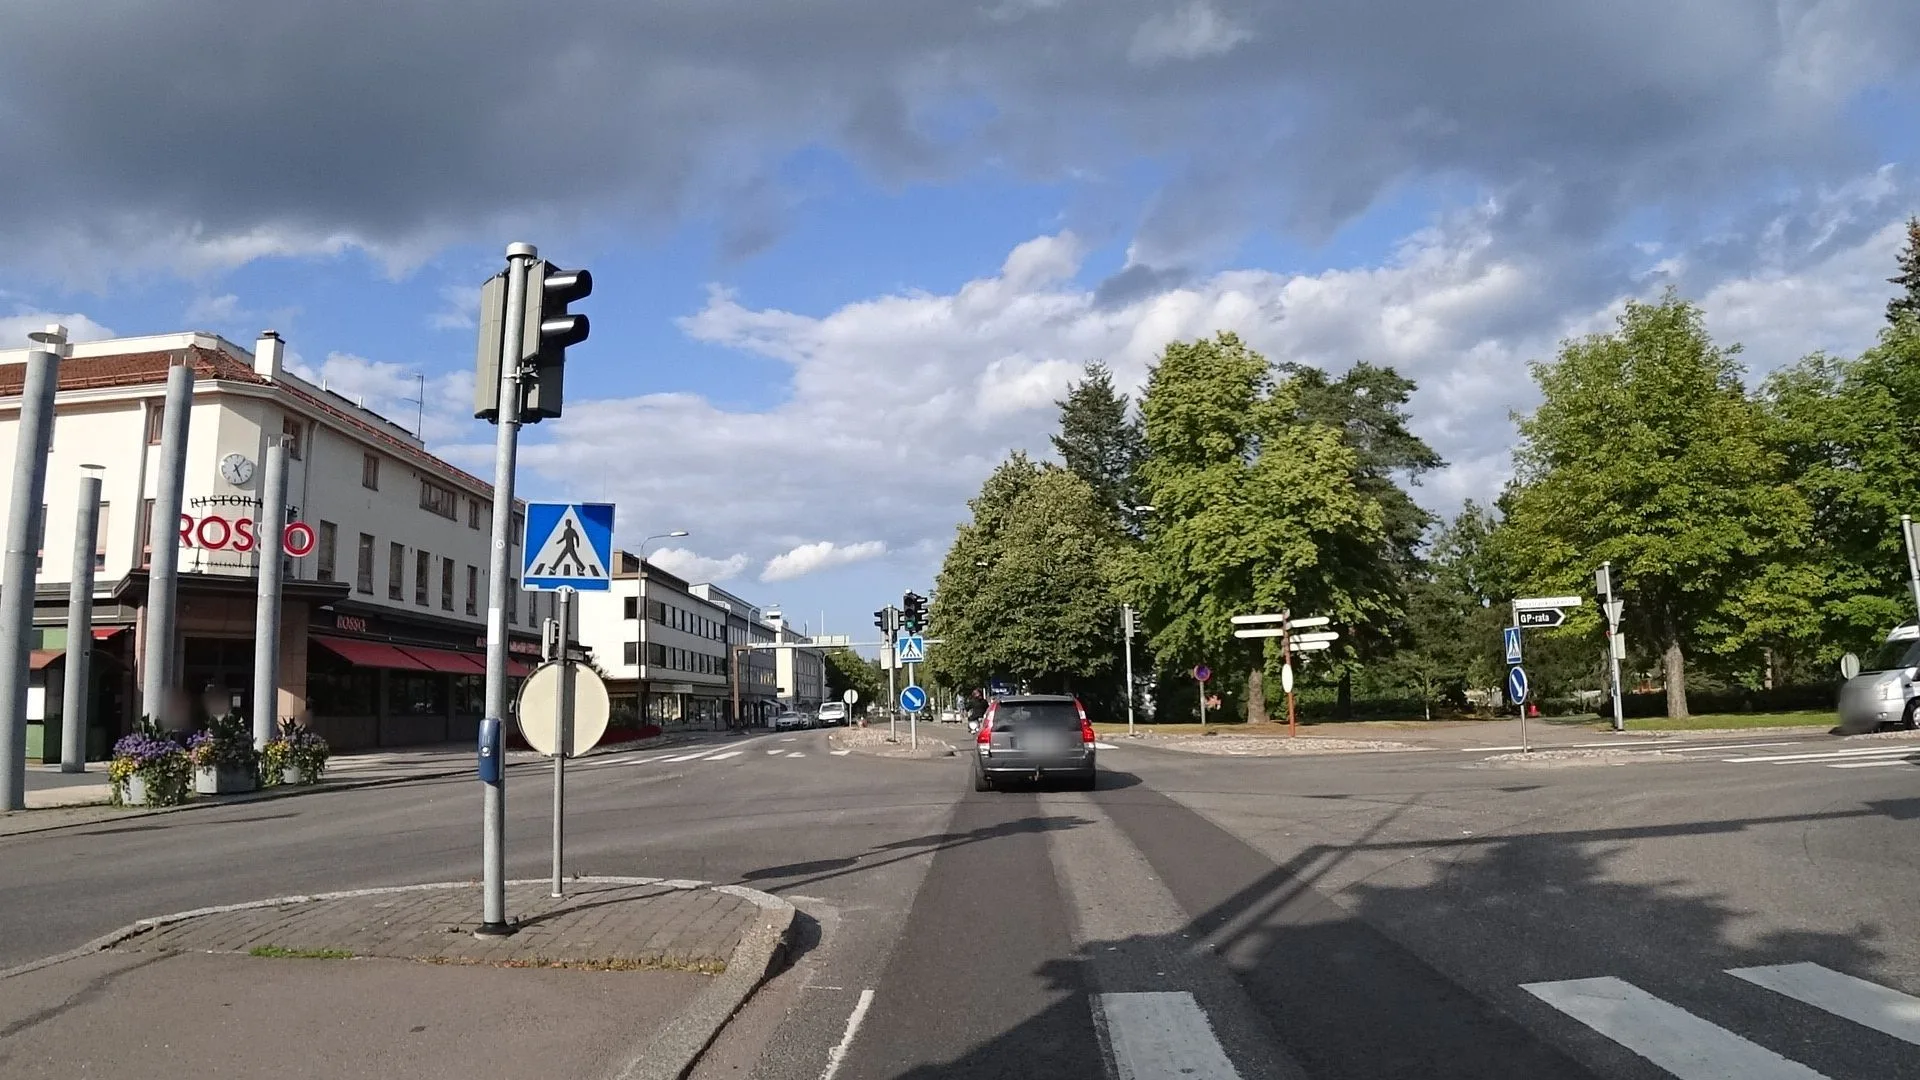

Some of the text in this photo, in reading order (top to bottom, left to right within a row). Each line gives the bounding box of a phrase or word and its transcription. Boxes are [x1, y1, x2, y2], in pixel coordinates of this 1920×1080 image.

[190, 495, 299, 518] RISTORAE
[180, 513, 315, 557] ROSO
[1520, 613, 1549, 623] GP-rata
